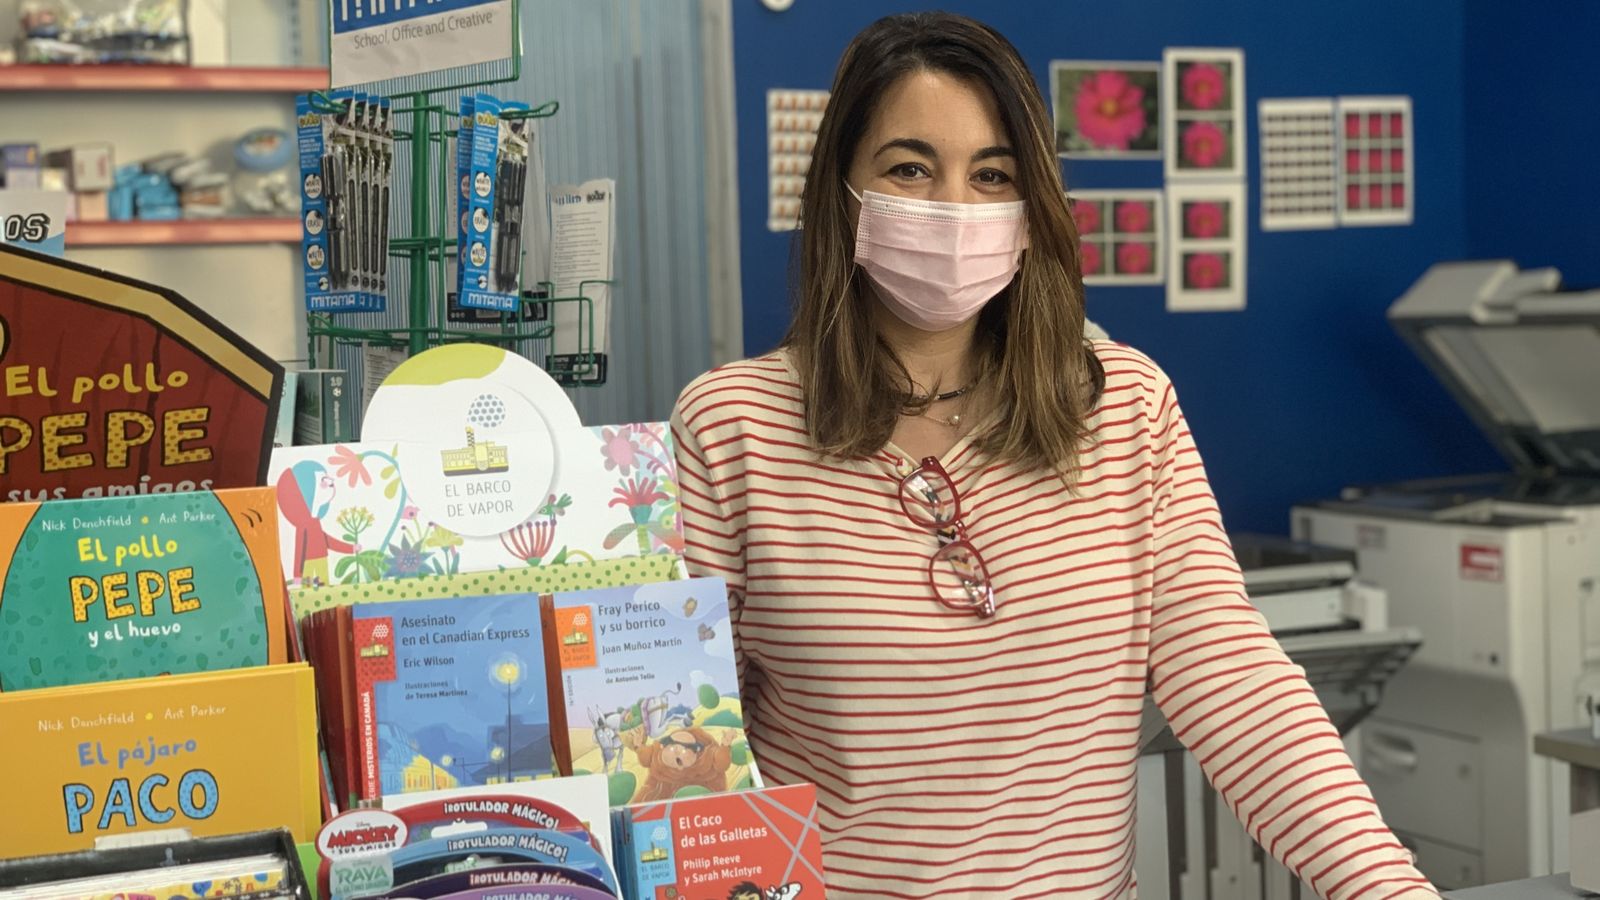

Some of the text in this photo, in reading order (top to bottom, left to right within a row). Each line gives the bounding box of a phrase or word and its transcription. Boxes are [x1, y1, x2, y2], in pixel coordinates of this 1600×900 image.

[354, 11, 493, 49] School, Office and Creative
[311, 294, 355, 308] MITAMA
[468, 293, 513, 309] MITAMA
[5, 363, 189, 404] El pollo
[0, 406, 214, 474] PEPE
[445, 480, 511, 498] EL BARCO
[447, 499, 514, 518] DE VAPOR
[42, 511, 216, 532] Nick Denchfield Ant Parker
[77, 534, 178, 566] El pollo
[69, 567, 201, 622] PEPE
[598, 600, 660, 618] Fray Perico
[401, 614, 456, 629] Asesinato
[600, 616, 666, 636] y su borrico
[88, 620, 181, 647] y el huevo
[402, 627, 530, 646] en el Canadian Express
[602, 645, 621, 656] Juan
[623, 641, 652, 653] Muñoz
[653, 636, 682, 650] Martín
[403, 655, 455, 669] Eric Wilson
[604, 665, 645, 675] Ilustraciones
[405, 681, 449, 690] Ilustraciones
[614, 675, 639, 683] Antonio
[416, 691, 438, 699] Teresa
[38, 720, 64, 732] Nick
[71, 713, 135, 729] Denchfield
[191, 705, 227, 717] Parker
[365, 724, 372, 736] EN
[77, 736, 197, 769] El pájaro
[366, 737, 375, 779] MISTERIOS
[63, 769, 219, 834] PACO
[444, 801, 559, 831] ¡ROTULADOR MÁGICO!
[679, 814, 722, 829] El Caco
[327, 824, 398, 848] MICKEY
[681, 827, 767, 848] de las Galletas
[359, 842, 396, 851] AMIGOS
[448, 834, 568, 863] ¡ROTULADOR MÁGICO!
[683, 854, 741, 870] Philip Reeve
[335, 866, 387, 883] RAYA
[684, 865, 762, 886] y Sarah McIntyre
